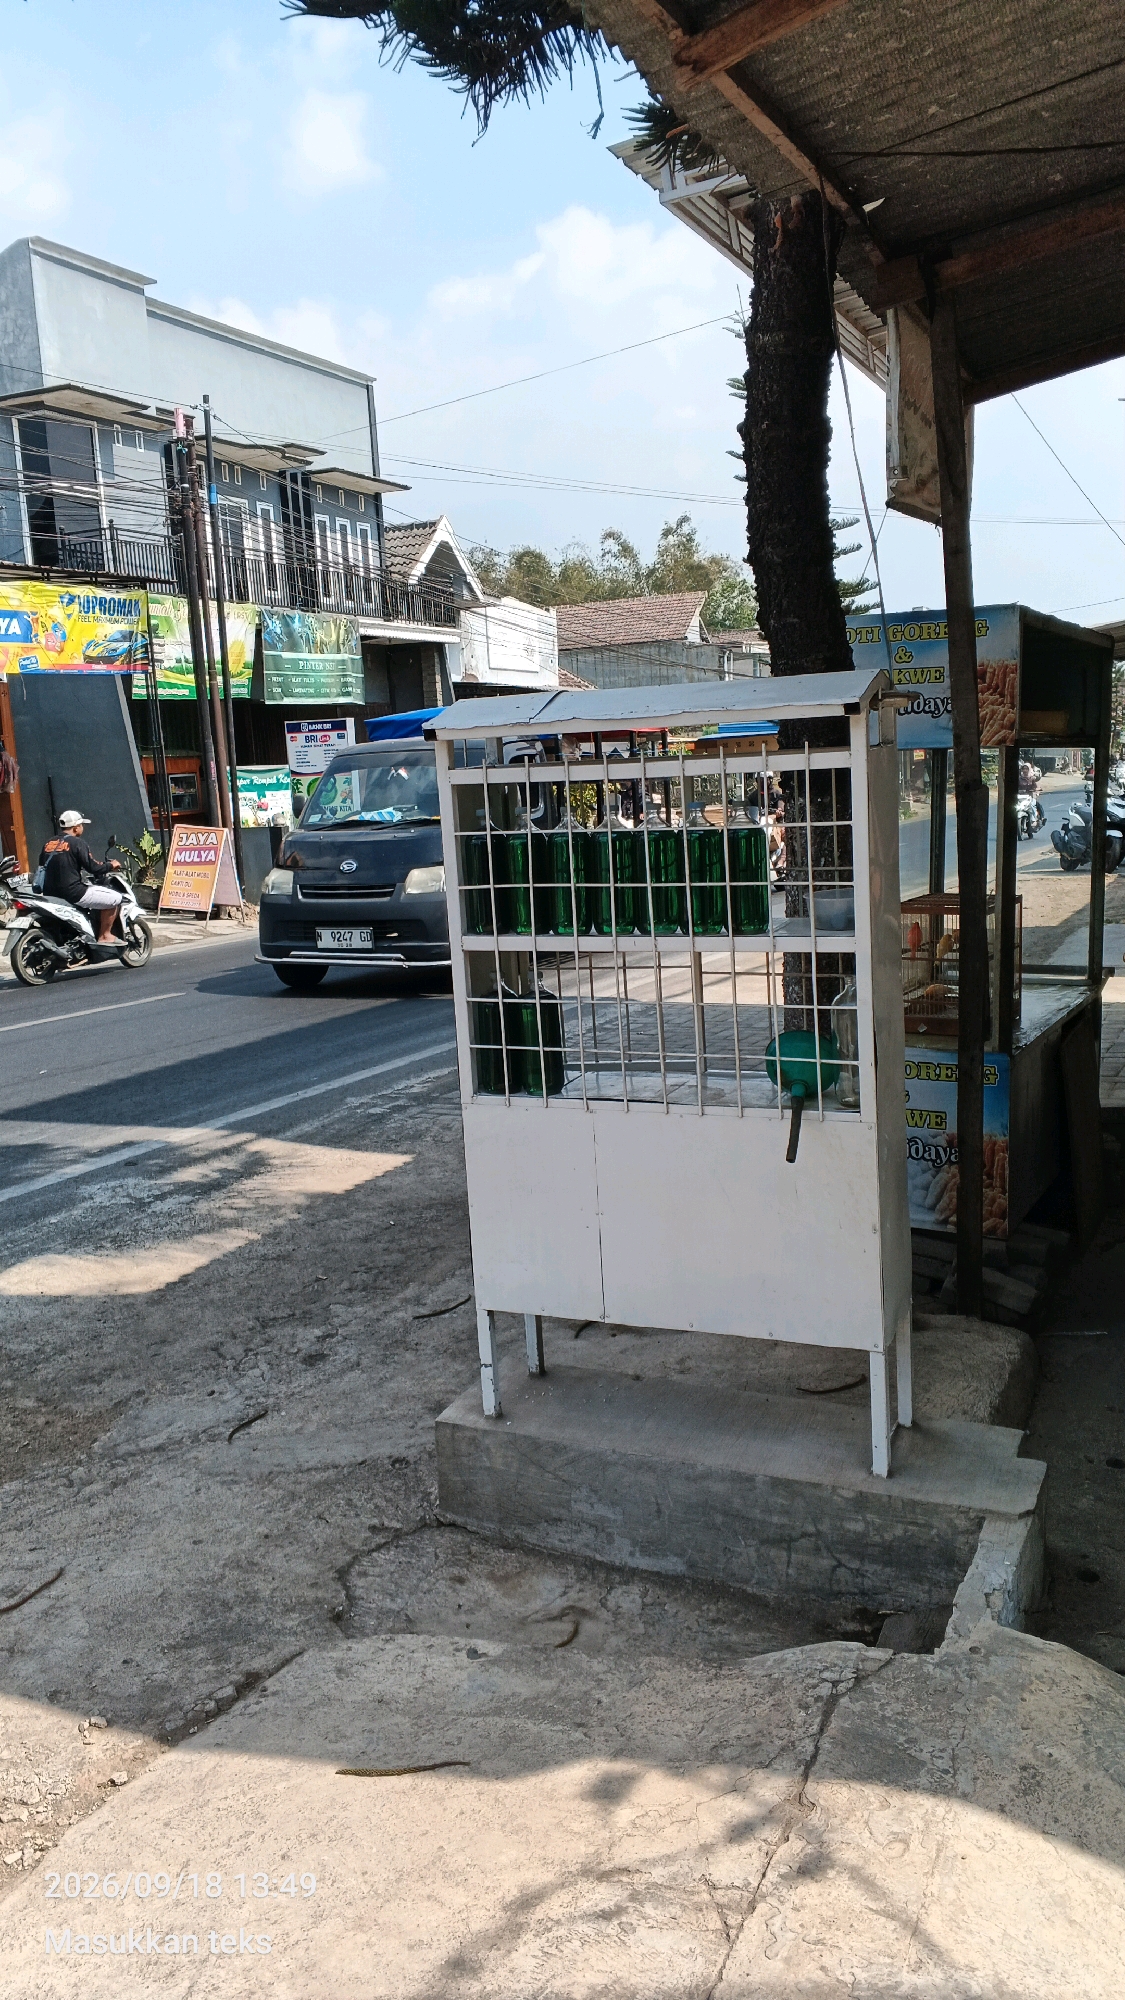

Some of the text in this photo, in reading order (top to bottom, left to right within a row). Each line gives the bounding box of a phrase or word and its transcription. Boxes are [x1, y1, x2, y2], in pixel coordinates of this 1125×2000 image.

[845, 619, 990, 645] OTI GOREG
[894, 646, 913, 664] &
[890, 667, 945, 685] KWE
[304, 735, 318, 743] BRI
[177, 832, 218, 846] JAYA
[174, 850, 215, 863] MULYA
[331, 931, 353, 943] 9247
[905, 1060, 998, 1086] OREG
[905, 1109, 947, 1130] WE
